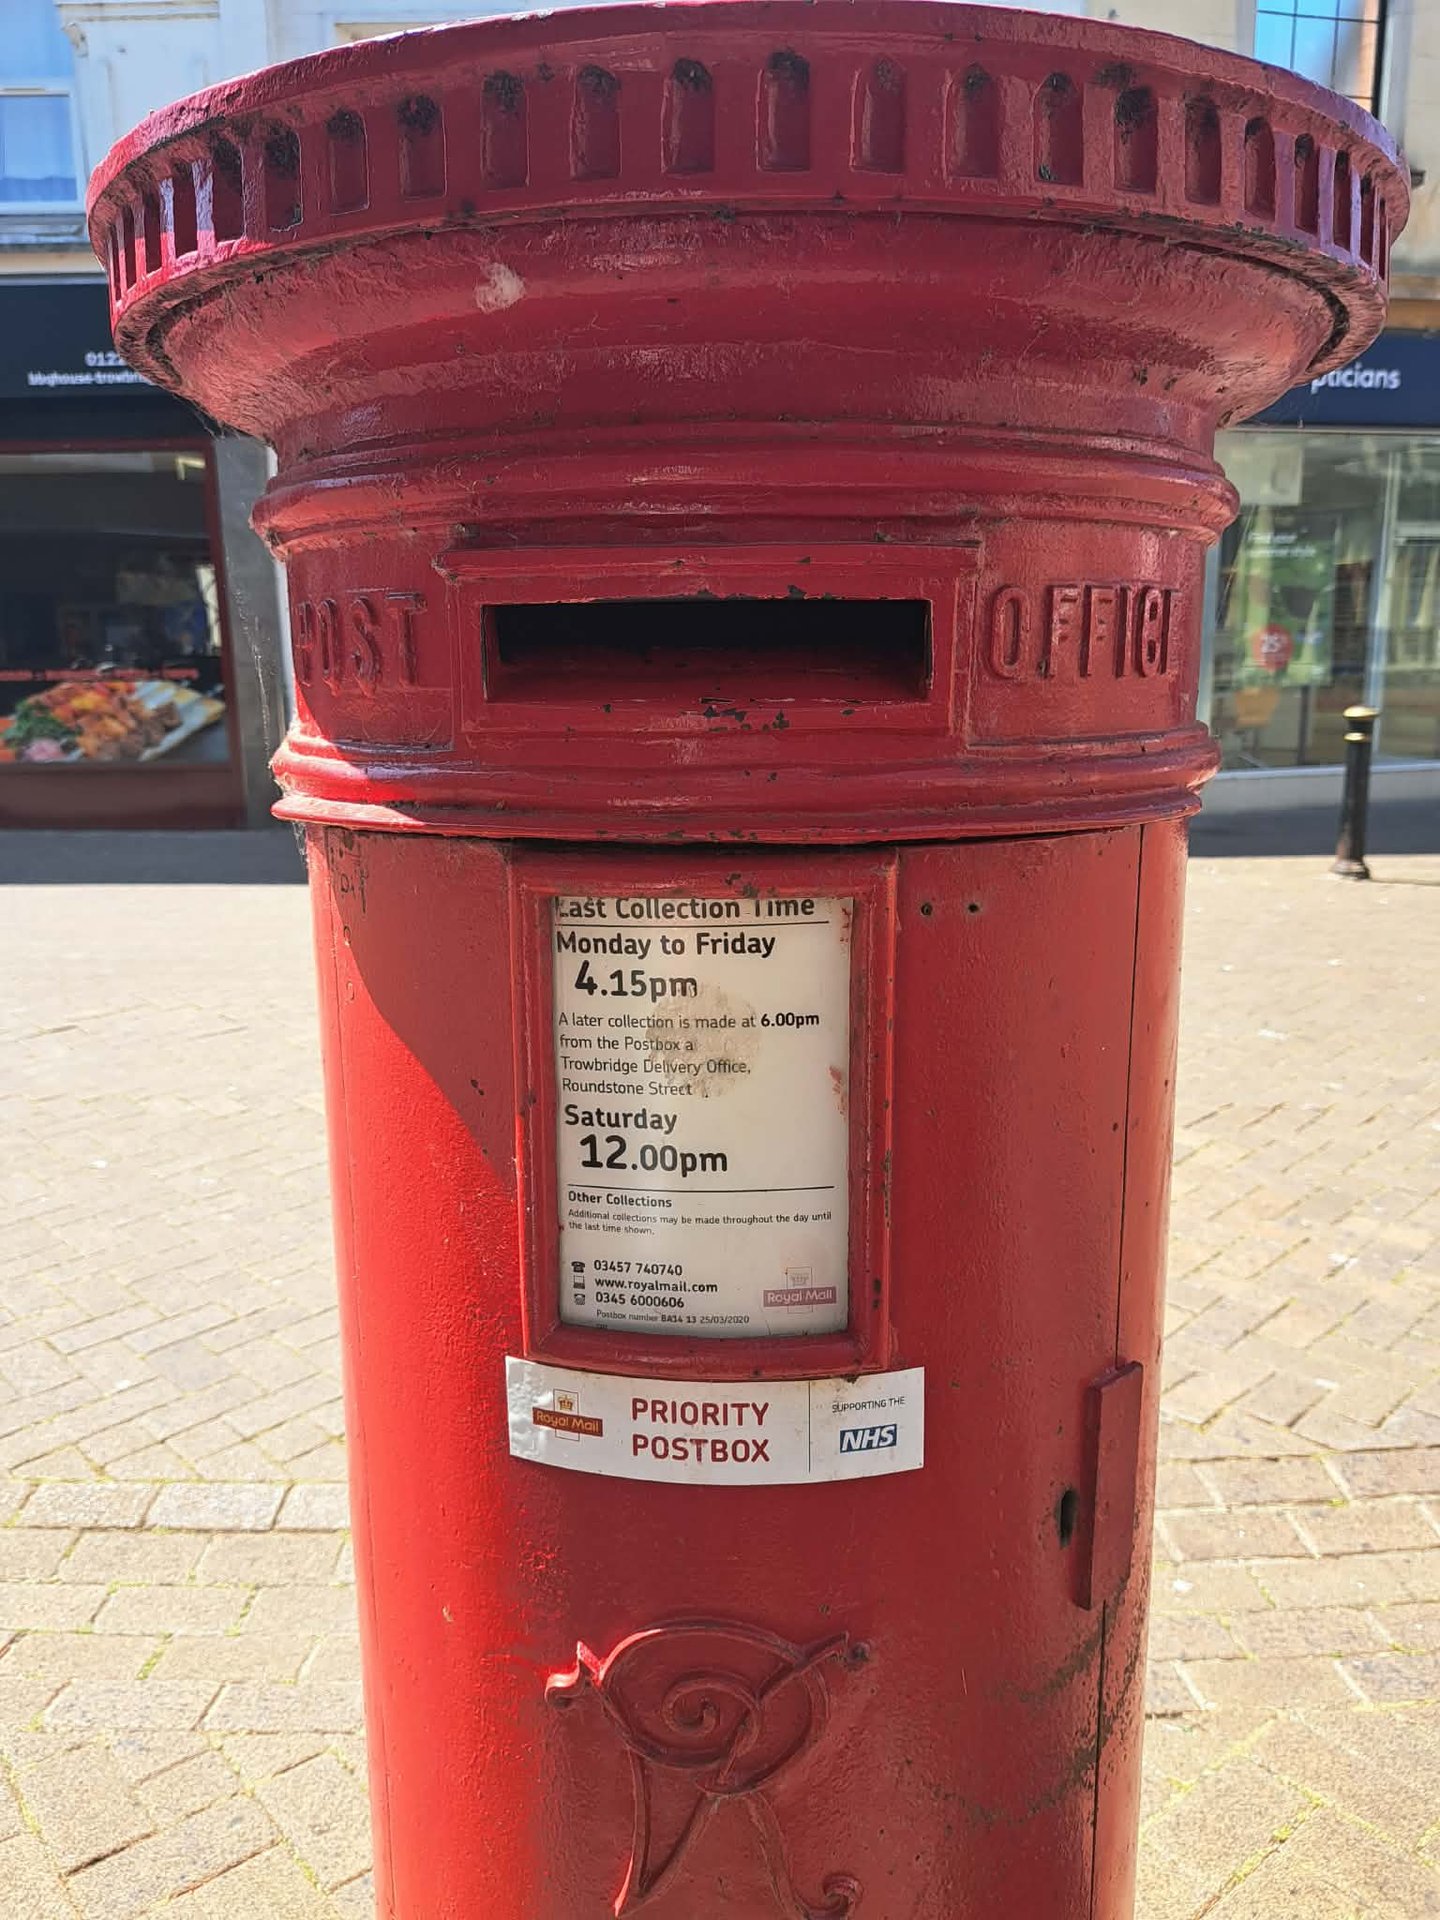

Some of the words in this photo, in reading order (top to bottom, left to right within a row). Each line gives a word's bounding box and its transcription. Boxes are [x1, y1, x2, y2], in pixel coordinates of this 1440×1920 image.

[615, 898, 740, 919] Collection
[556, 931, 651, 959] Monday
[660, 935, 685, 955] to
[696, 931, 776, 958] Friday
[575, 960, 698, 1003] 4.15pm
[558, 1012, 568, 1026] A
[572, 1012, 603, 1027] later
[608, 1014, 674, 1028] collection
[679, 1014, 690, 1028] is
[695, 1015, 736, 1029] made
[741, 1016, 757, 1028] at
[760, 1012, 820, 1029] 6.00pm
[560, 1034, 592, 1049] from
[597, 1036, 620, 1050] the
[624, 1036, 681, 1051] Postbox
[561, 1056, 638, 1075] Trowbridge
[643, 1058, 701, 1076] Delivery
[706, 1059, 751, 1074] Office,
[562, 1078, 644, 1095] Roundstone
[564, 1104, 678, 1134] Saturday
[579, 1134, 728, 1178] 12.00pm
[568, 1190, 602, 1204] Other
[606, 1193, 672, 1208] Collections
[568, 1209, 610, 1220] Additional
[612, 1213, 657, 1223] collections
[660, 1215, 678, 1225] may
[681, 1215, 692, 1224] be
[695, 1215, 720, 1225] made
[722, 1214, 774, 1225] throughout
[775, 1213, 791, 1223] the
[793, 1211, 809, 1223] day
[811, 1211, 832, 1221] until
[568, 1221, 582, 1230] the
[584, 1222, 600, 1231] last
[602, 1223, 622, 1233] time
[624, 1225, 655, 1235] shown.
[593, 1259, 631, 1273] 03457
[635, 1262, 683, 1276] 740740
[595, 1277, 718, 1293] www.royalmail.com
[595, 1291, 626, 1305] 0345
[630, 1294, 685, 1308] 6000606
[767, 1291, 803, 1305] Royal
[804, 1289, 833, 1301] Mail
[596, 1309, 627, 1320] Postbox
[631, 1397, 769, 1427] PRIORITY
[832, 1399, 887, 1414] SUPPORTING
[888, 1396, 906, 1407] THE
[536, 1411, 569, 1427] Royal
[572, 1418, 599, 1434] Mail
[841, 1425, 895, 1452] NHS
[632, 1433, 770, 1464] POSTBOX
